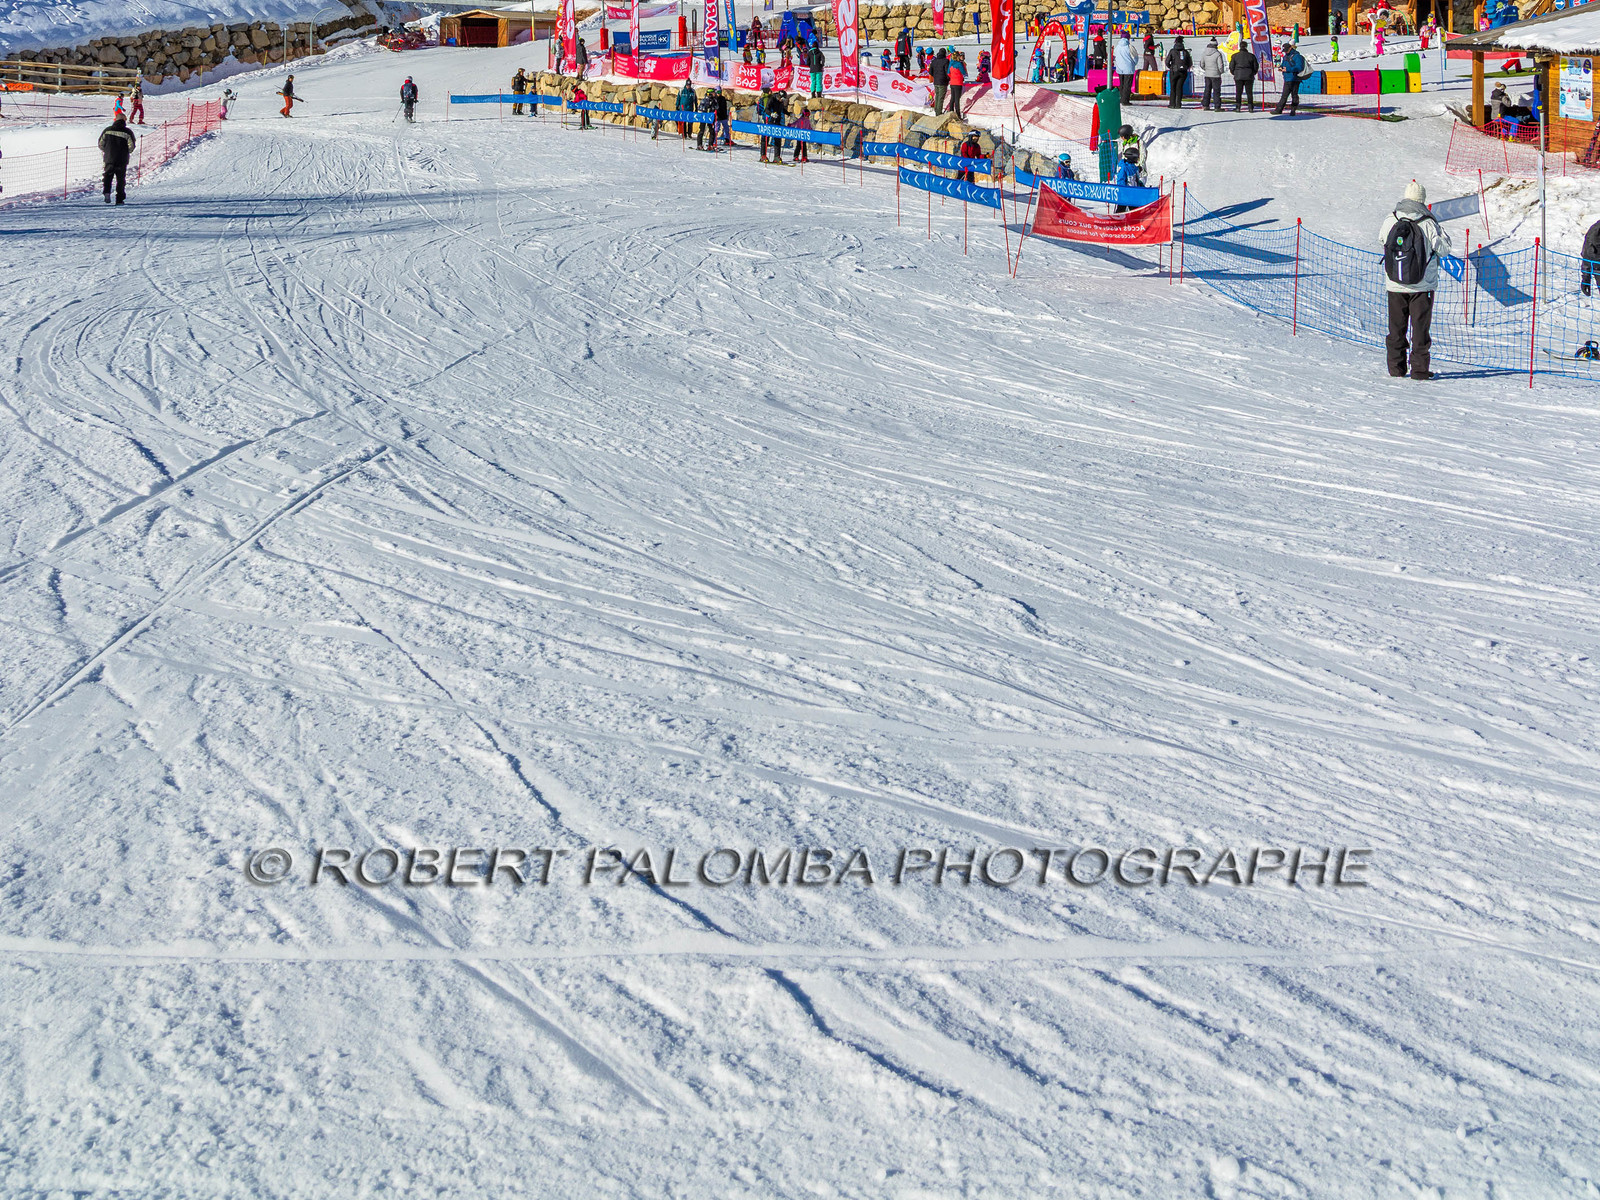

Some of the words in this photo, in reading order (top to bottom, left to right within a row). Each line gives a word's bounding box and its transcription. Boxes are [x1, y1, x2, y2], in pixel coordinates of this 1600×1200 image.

[739, 65, 757, 78] AIR
[735, 77, 758, 88] BAG
[756, 124, 771, 134] TAPIS
[771, 127, 781, 136] DES
[782, 128, 811, 141] CHAUVETS
[1047, 179, 1068, 194] TAPIS
[1069, 182, 1084, 196] DES
[1084, 183, 1120, 201] CHAUVETS
